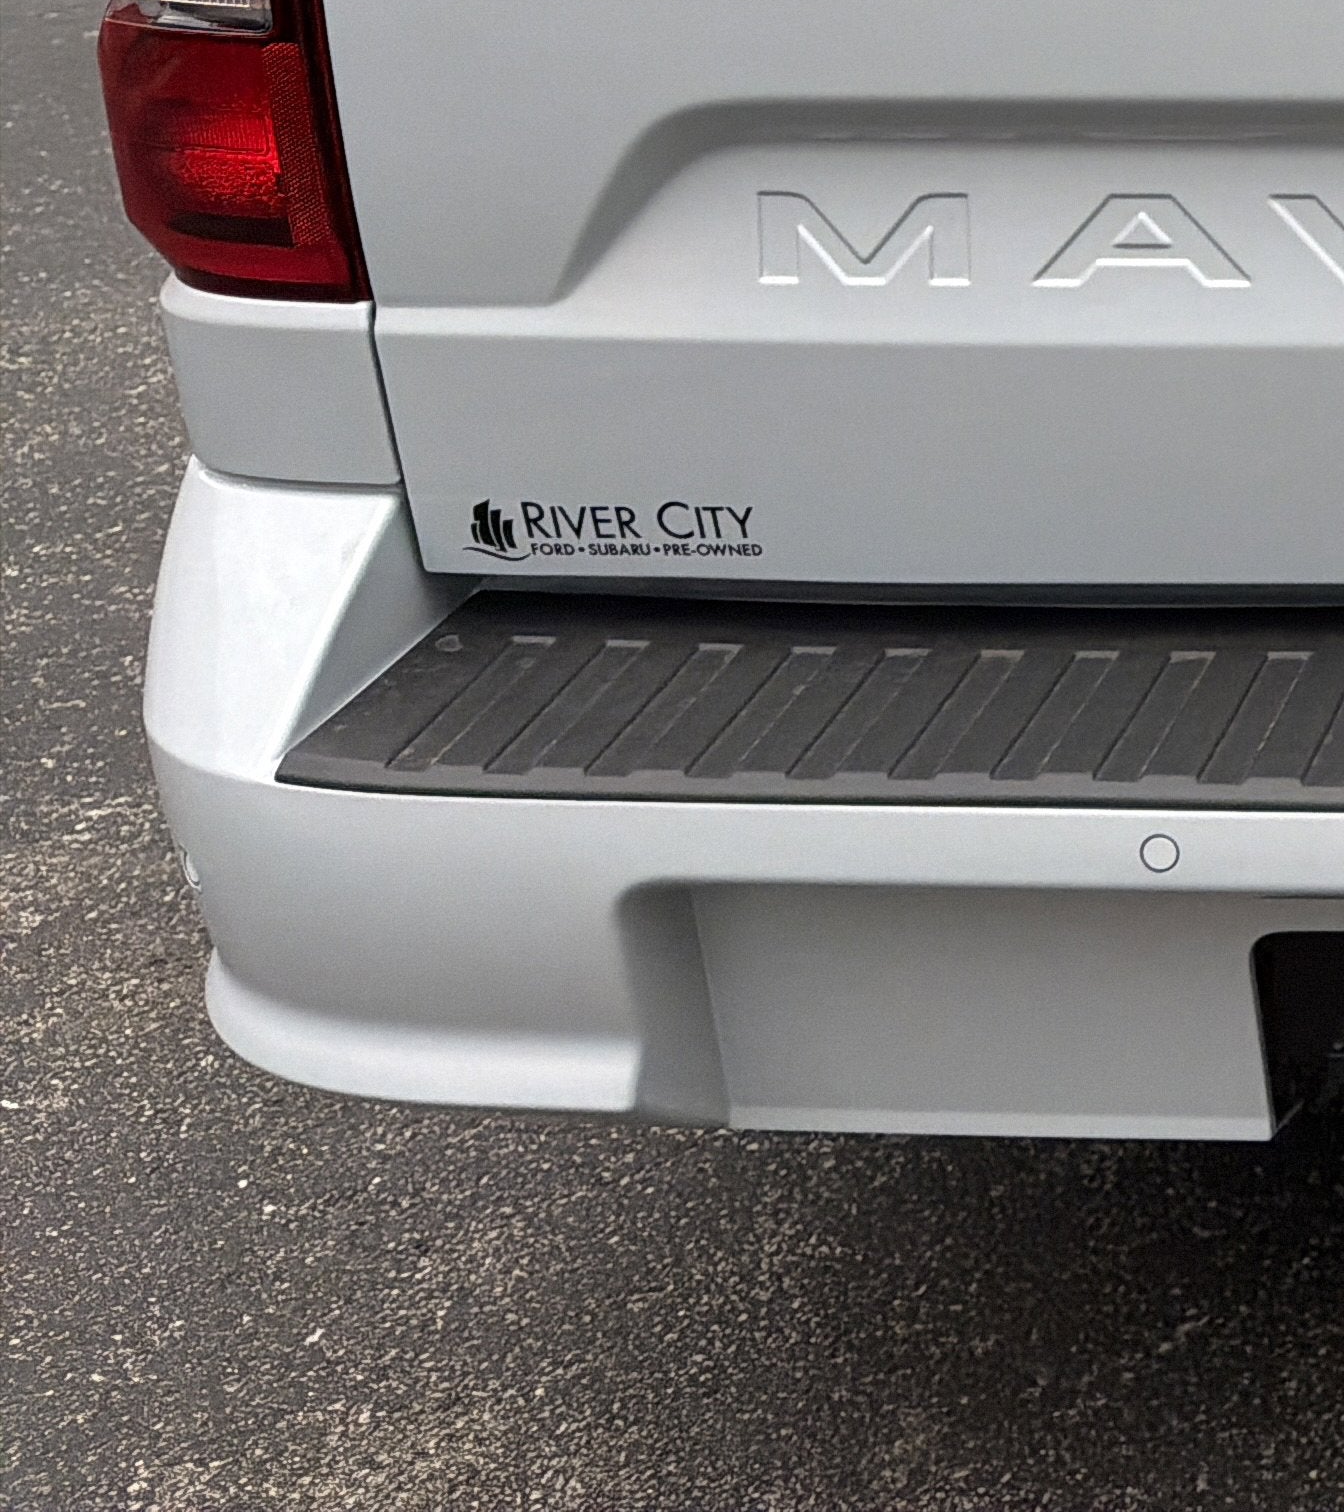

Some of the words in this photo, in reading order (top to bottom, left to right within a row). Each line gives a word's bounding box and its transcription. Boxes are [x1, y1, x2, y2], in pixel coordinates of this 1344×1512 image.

[520, 501, 643, 540] RIVER
[656, 501, 754, 539] CITY
[530, 543, 576, 557] FORD
[588, 543, 652, 557] SUBARU
[663, 543, 763, 557] PRE-OWNED
